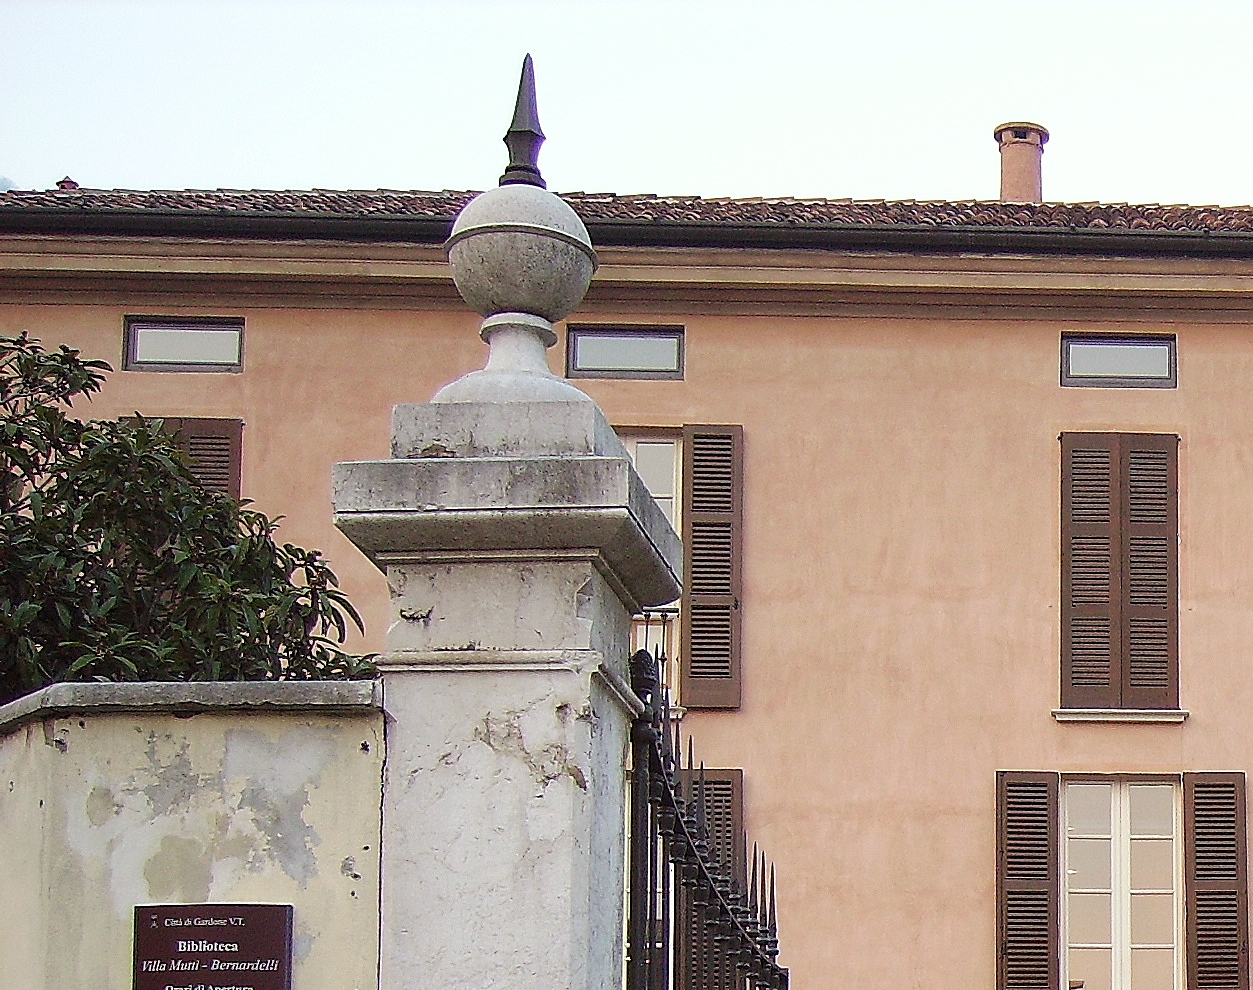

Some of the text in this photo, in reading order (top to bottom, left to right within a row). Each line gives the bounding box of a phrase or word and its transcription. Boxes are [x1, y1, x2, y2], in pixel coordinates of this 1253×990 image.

[184, 917, 192, 926] di
[193, 917, 228, 926] Gardone
[229, 917, 246, 927] V.T.
[178, 940, 239, 952] Biblioteca
[142, 960, 167, 971] Villa
[169, 959, 201, 971] Mutti
[210, 959, 280, 971] Bernardelli
